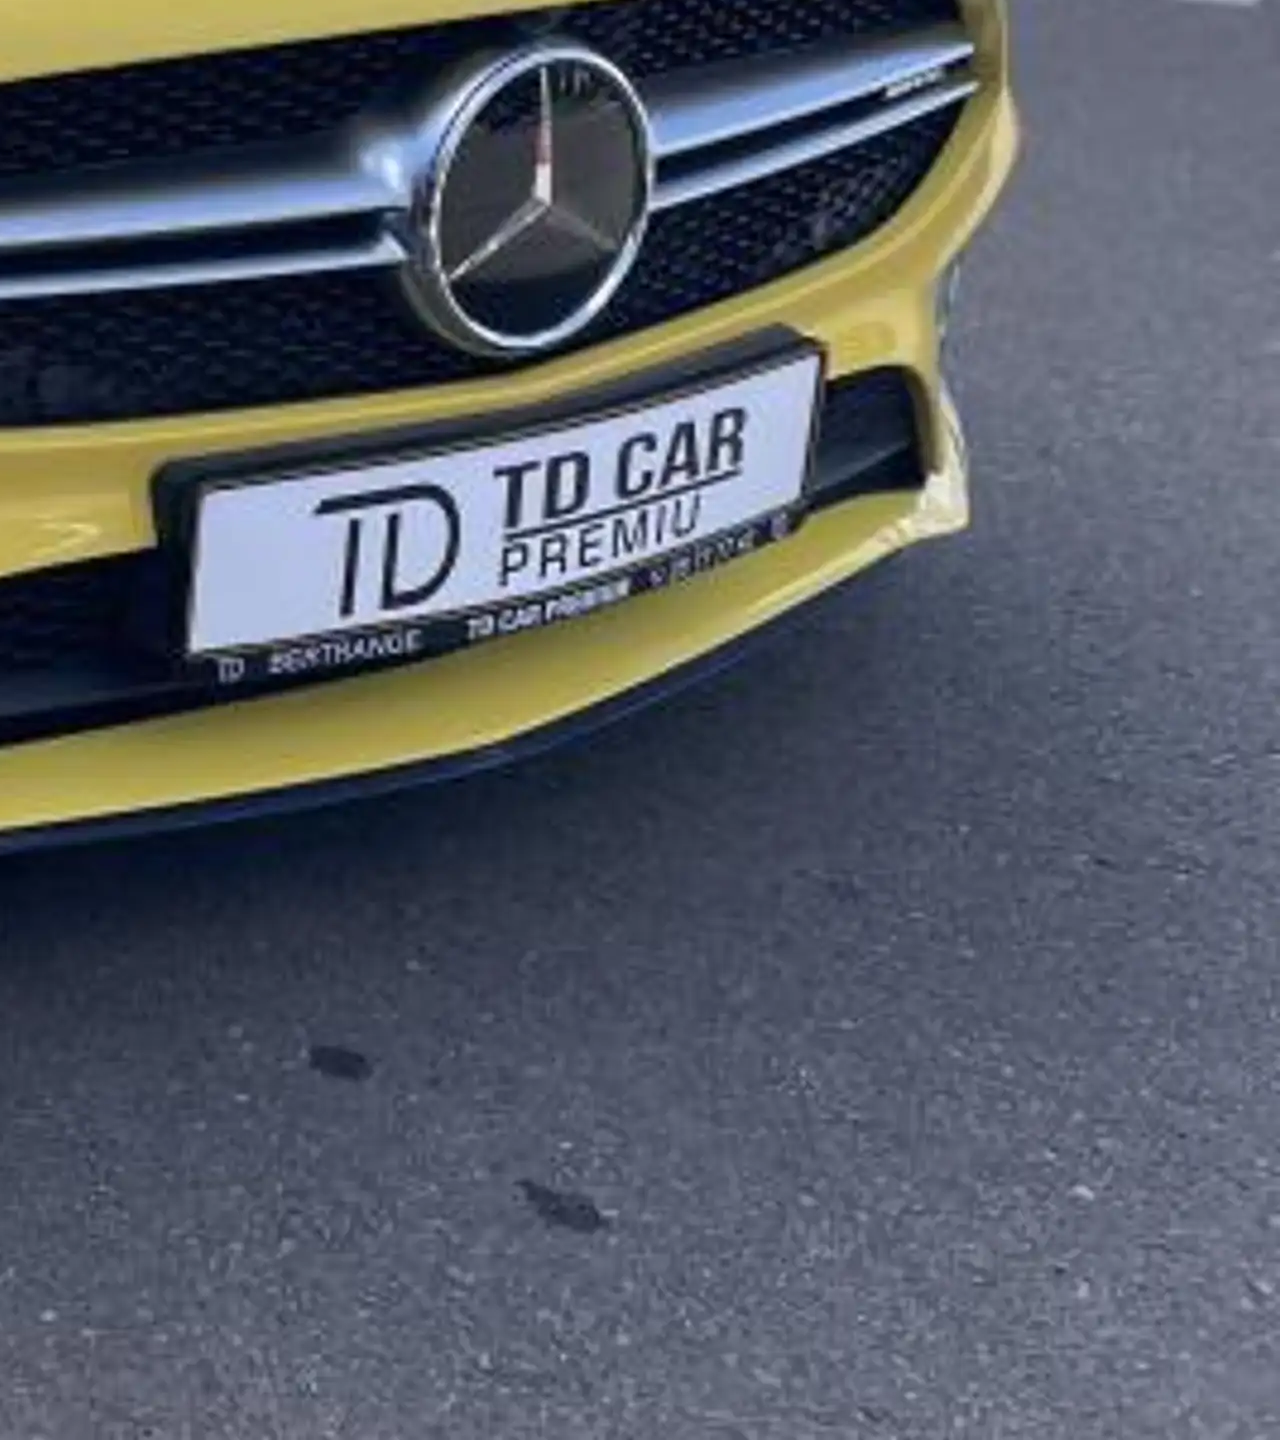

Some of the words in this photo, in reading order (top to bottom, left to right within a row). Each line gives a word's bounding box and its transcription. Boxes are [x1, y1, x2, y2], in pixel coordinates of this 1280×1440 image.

[493, 452, 591, 529] TD
[616, 407, 747, 500] CAR
[314, 483, 461, 618] TD
[497, 494, 702, 586] PREMIU
